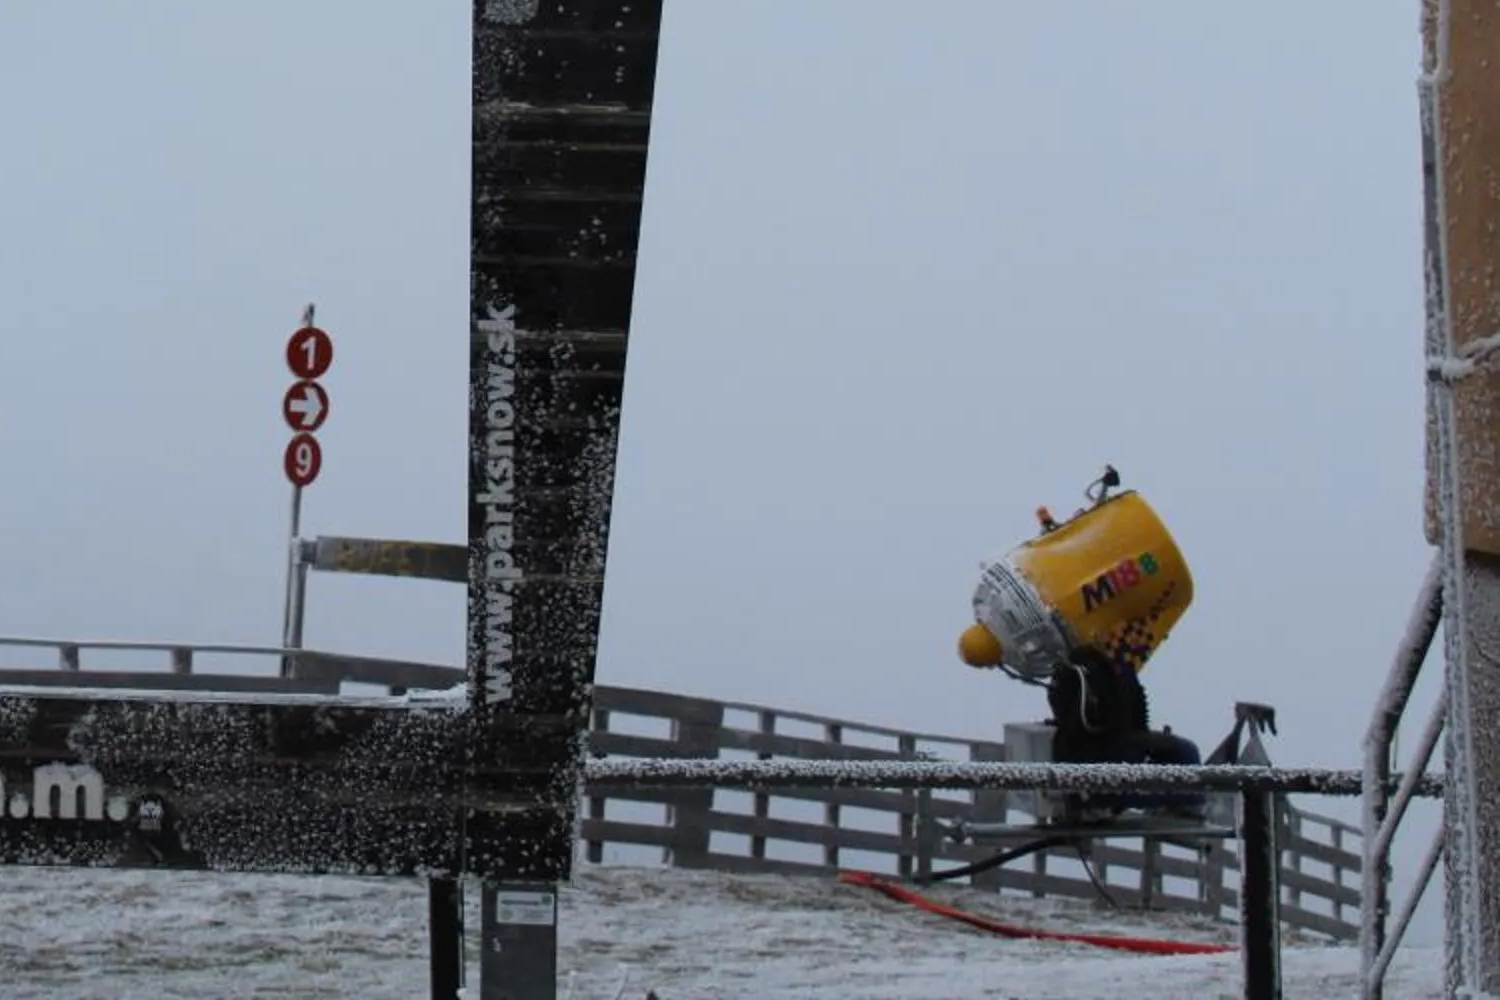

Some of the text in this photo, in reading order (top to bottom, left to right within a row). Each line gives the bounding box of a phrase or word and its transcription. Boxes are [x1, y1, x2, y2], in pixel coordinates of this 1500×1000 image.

[301, 336, 316, 370] 1
[297, 443, 312, 477] 9
[476, 301, 523, 703] www.parksnow.sk
